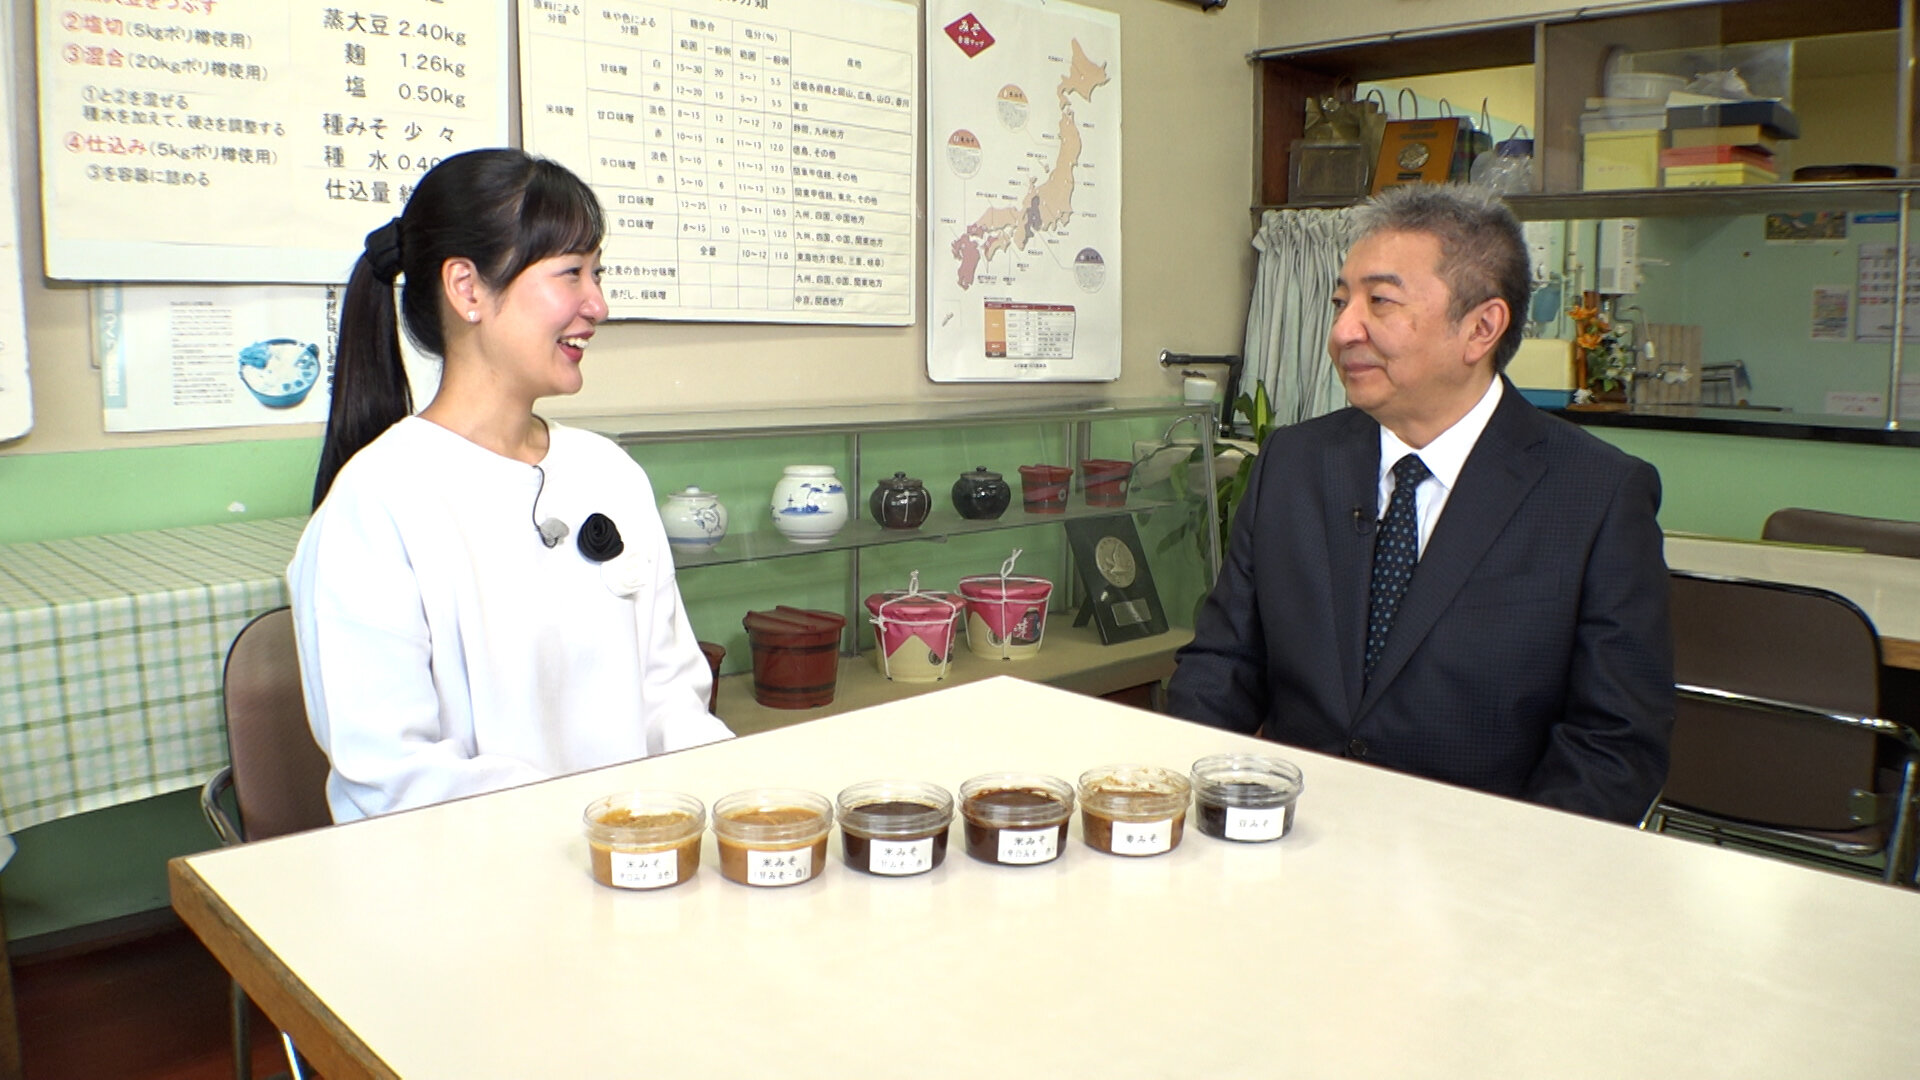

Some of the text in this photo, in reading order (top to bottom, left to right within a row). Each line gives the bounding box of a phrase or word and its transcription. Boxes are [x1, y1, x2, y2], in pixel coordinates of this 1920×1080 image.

[323, 8, 467, 46] 蒸大豆 2.40kg
[400, 53, 466, 78] 1.26kg
[345, 75, 466, 108] 塩 0.50kg
[323, 113, 388, 140] 種みそ
[325, 178, 391, 204] 仕込量
